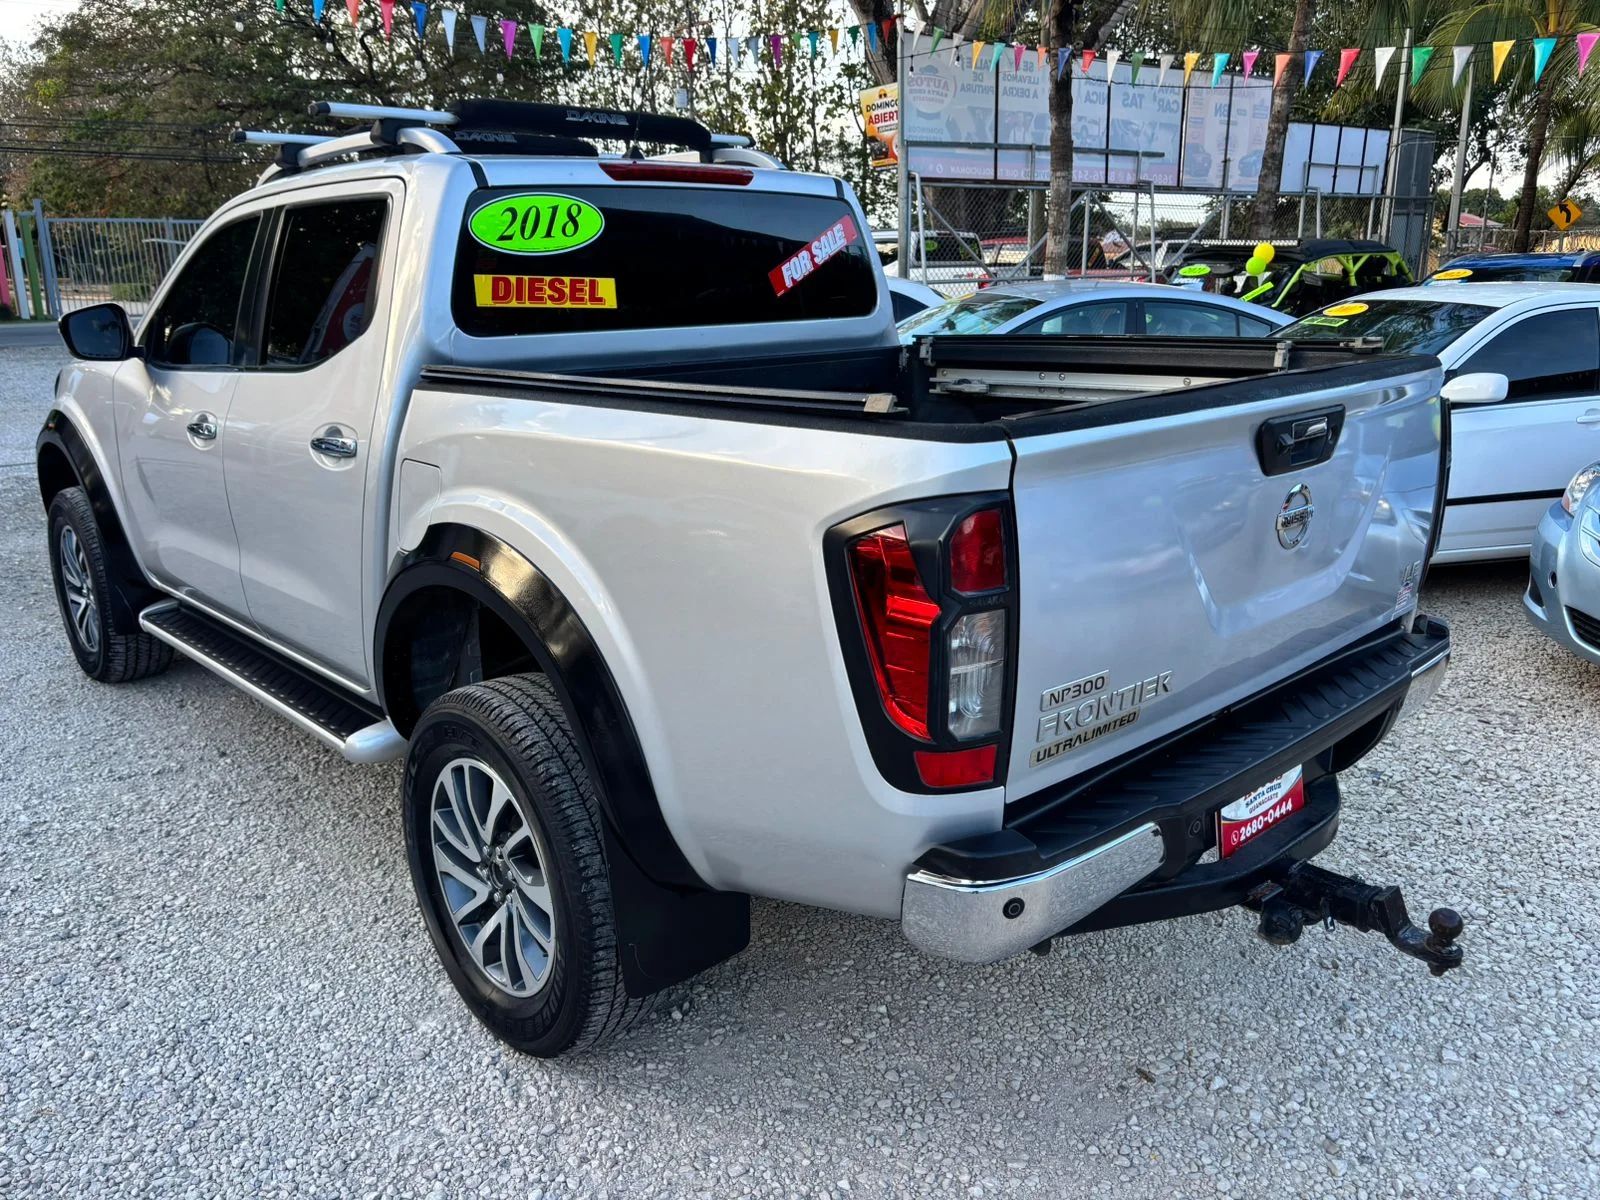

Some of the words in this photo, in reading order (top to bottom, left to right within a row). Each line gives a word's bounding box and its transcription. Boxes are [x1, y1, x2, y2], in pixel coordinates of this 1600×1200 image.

[566, 110, 629, 126] DAKINE
[868, 110, 898, 126] ABIERT
[454, 131, 517, 144] DAKINE
[496, 203, 583, 242] 2018
[781, 250, 815, 288] FOR
[811, 223, 847, 265] SALE
[491, 275, 606, 305] DIESEL
[1035, 669, 1173, 743] FRONTIER
[1049, 675, 1105, 707] NP300
[1036, 711, 1137, 763] ULTRALIMITED
[1244, 790, 1265, 808] SANTA
[1265, 782, 1282, 795] CRUZ
[1248, 792, 1279, 815] GUANACASTE
[1239, 798, 1293, 842] 2680-0444
